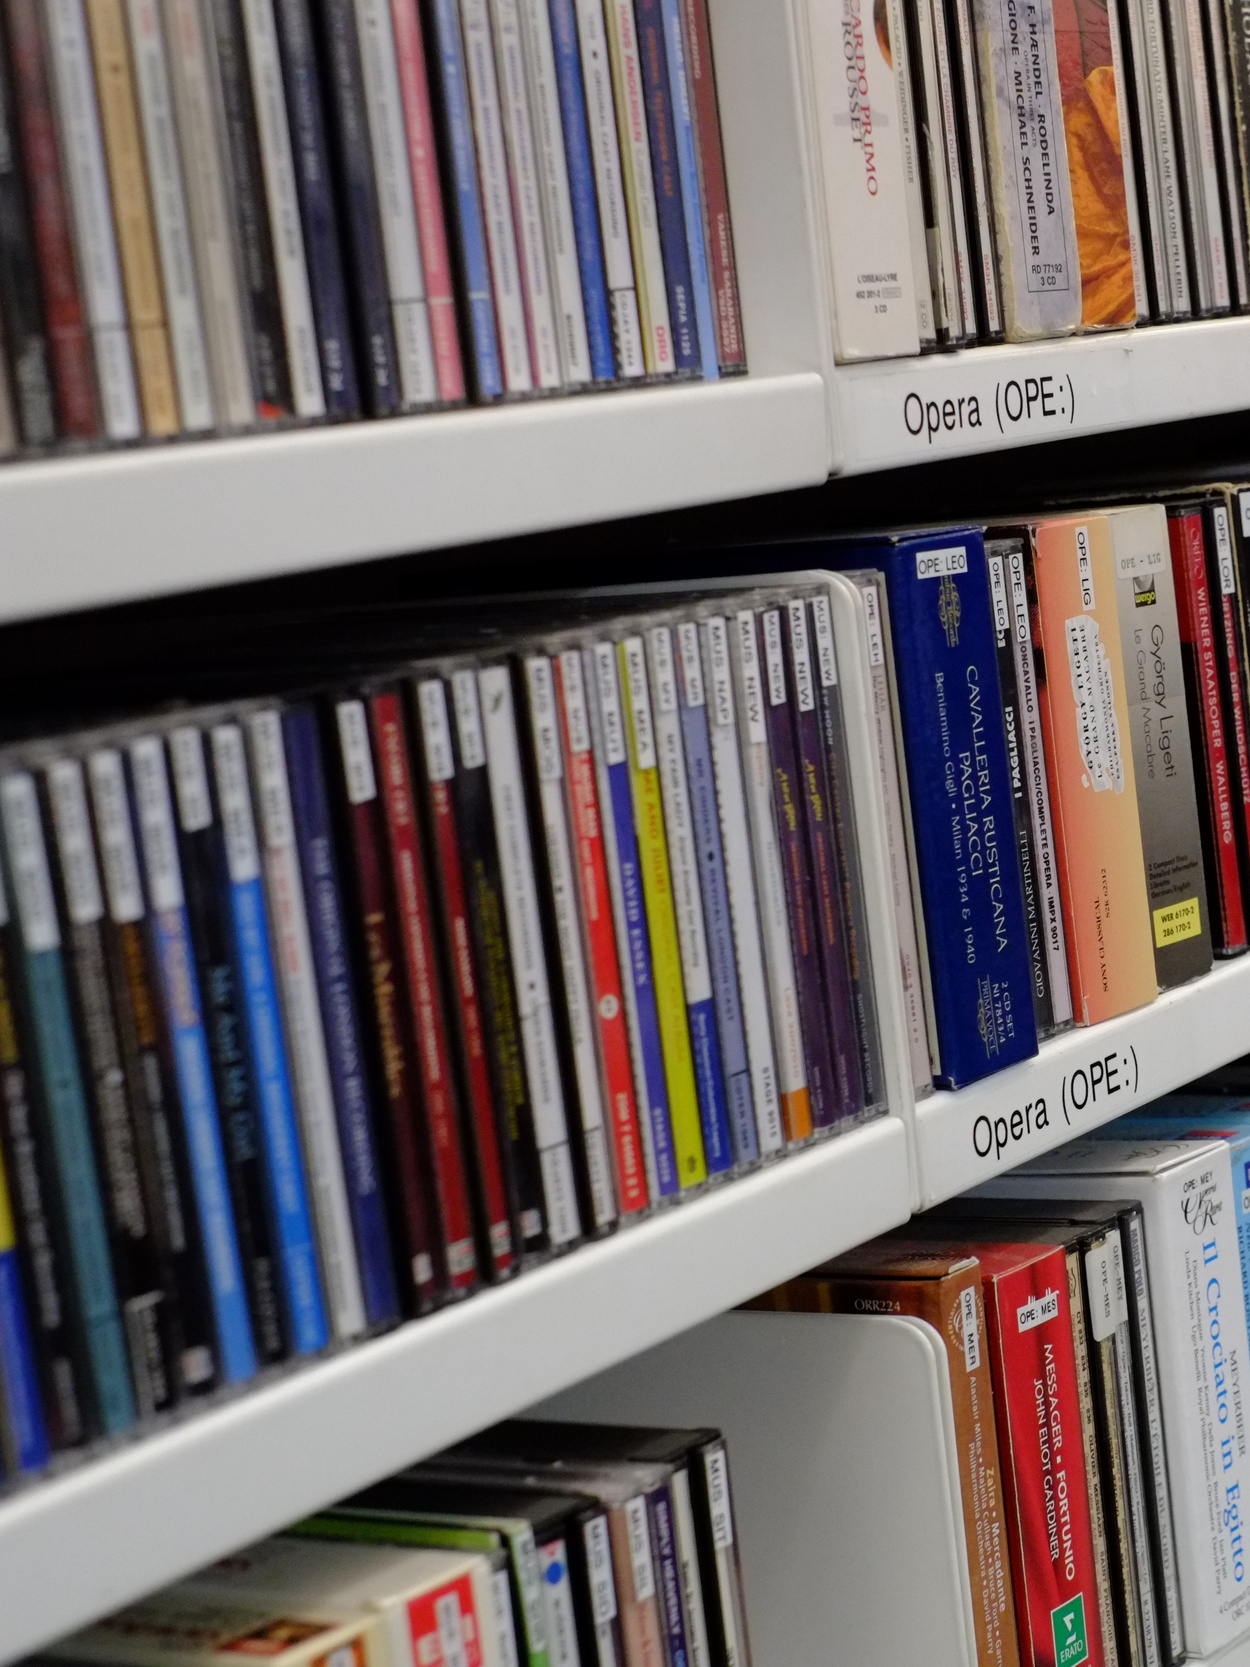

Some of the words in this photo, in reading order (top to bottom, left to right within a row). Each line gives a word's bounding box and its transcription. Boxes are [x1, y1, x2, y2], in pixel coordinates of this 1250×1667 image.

[1027, 5, 1036, 17] F.
[1023, 50, 1031, 80] OPERA
[1028, 23, 1044, 100] HÆNDEL
[842, 21, 863, 148] ROUSSET
[892, 14, 903, 60] PALACIO
[898, 69, 910, 134] WEIDINGER
[905, 144, 914, 184] FISHER
[1026, 82, 1032, 93] IN
[1028, 95, 1036, 124] THREE
[861, 106, 878, 196] PRIMO
[1013, 70, 1029, 150] MICHAEL
[1022, 156, 1040, 256] SCHNEIDER
[1037, 113, 1056, 216] RODELINDA
[1031, 265, 1042, 274] RD
[1043, 264, 1063, 274] 77192
[1040, 277, 1045, 286] 3
[1046, 276, 1057, 286] CD
[675, 285, 688, 323] SEPIA
[656, 326, 668, 362] DRG
[680, 329, 691, 356] 1125
[903, 391, 981, 443] Opera
[994, 373, 1076, 434] (OPE:)
[1077, 531, 1089, 573] OPE:
[1216, 513, 1228, 553] OPE:
[918, 556, 944, 575] OPE:
[945, 554, 966, 571] LEO
[992, 561, 1002, 594] OPE:
[1011, 555, 1022, 597] OPE:
[1220, 557, 1232, 589] LOR
[866, 592, 877, 628] OPE:
[1081, 577, 1092, 607] LIG
[1135, 592, 1156, 604] wergo
[790, 606, 806, 654] MUS:
[815, 600, 828, 640] MUS:
[996, 600, 1006, 627] LEO
[1015, 602, 1028, 640] LEO
[1197, 587, 1212, 647] WIENER
[870, 633, 881, 663] LEH
[1134, 628, 1144, 645] Le
[821, 646, 834, 682] NEW
[1070, 627, 1084, 690] LIGETI
[1136, 649, 1151, 702] Grand
[1150, 625, 1168, 709] György
[717, 679, 730, 721] NAP
[747, 676, 759, 724] NEW
[771, 662, 783, 701] NEW
[797, 661, 810, 708] NEW
[1203, 651, 1222, 748] STAATSOPER
[934, 672, 950, 758] Beniamino
[1079, 700, 1093, 771] GYÖRGY
[1142, 706, 1155, 780] Macabre
[1158, 714, 1177, 778] Ligeti
[945, 761, 958, 797] Gigli
[959, 751, 983, 876] PAGLIACCI
[966, 665, 992, 810] CAVALLERIA
[982, 815, 1008, 953] RUSTICANA
[1215, 760, 1233, 845] WALLBERG
[951, 815, 963, 859] Milan
[956, 865, 969, 903] 1934
[1019, 830, 1036, 920] MARTINELLI
[961, 907, 971, 920] &
[1094, 897, 1106, 959] CLASSICAL
[1161, 912, 1175, 924] WER
[1175, 905, 1195, 919] 6170-2
[1162, 926, 1175, 938] 286
[1175, 921, 1192, 933] 170-2
[963, 926, 977, 964] 1940
[1029, 922, 1045, 998] GIOVANNI
[992, 983, 1000, 998] NI
[1101, 961, 1109, 992] SONY
[981, 980, 991, 1019] PRIMA
[986, 1019, 998, 1054] VOCE
[1003, 991, 1011, 1011] CD
[995, 1001, 1006, 1044] 7843/4
[1006, 1014, 1015, 1038] SET
[857, 993, 868, 1050] GHOSTLIGHT
[863, 1051, 874, 1094] RECORDS
[762, 1066, 775, 1106] STAGE
[972, 1097, 1050, 1160] Opera
[1061, 1045, 1140, 1126] (OPE:)
[1183, 1178, 1199, 1193] OPE:
[1200, 1171, 1213, 1185] MEY
[1203, 1237, 1218, 1267] Il
[854, 1298, 901, 1313] ORR224
[1101, 1260, 1111, 1318] OPE-MES
[1187, 1279, 1195, 1321] Kitchen
[964, 1292, 975, 1328] OPE:
[1019, 1307, 1039, 1326] OPE:
[1041, 1298, 1057, 1316] MES
[967, 1332, 978, 1367] MER
[1191, 1324, 1199, 1342] Ugo
[1206, 1277, 1229, 1424] Crociato
[1193, 1343, 1201, 1382] Benelli
[969, 1376, 980, 1420] Alastair
[1033, 1378, 1047, 1425] JOHN
[1197, 1386, 1205, 1416] Royal
[1229, 1350, 1247, 1458] MEYERBEER
[974, 1423, 983, 1456] Miles
[1038, 1429, 1052, 1472] ELIOT
[1200, 1417, 1212, 1483] Philharmonic
[1220, 1435, 1234, 1474] in
[968, 1442, 980, 1520] Philharmonia
[1043, 1343, 1063, 1452] MESSAGER
[1056, 1469, 1076, 1581] FORTUNIO
[978, 1466, 988, 1510] Majella
[1207, 1484, 1216, 1532] Orchestra
[714, 1512, 728, 1545] SIT
[983, 1511, 993, 1555] Cullagh
[1043, 1476, 1060, 1562] GARDINER
[1224, 1480, 1245, 1582] Egitto
[976, 1520, 986, 1577] Orchestra
[985, 1466, 996, 1508] Zaira
[992, 1522, 1007, 1613] Mercadante
[1211, 1535, 1219, 1562] David
[988, 1567, 996, 1600] Bruce
[1214, 1564, 1222, 1595] Parry
[983, 1589, 992, 1621] David
[991, 1601, 999, 1628] Ford
[986, 1625, 994, 1654] Parry
[1060, 1639, 1084, 1663] ERATO
